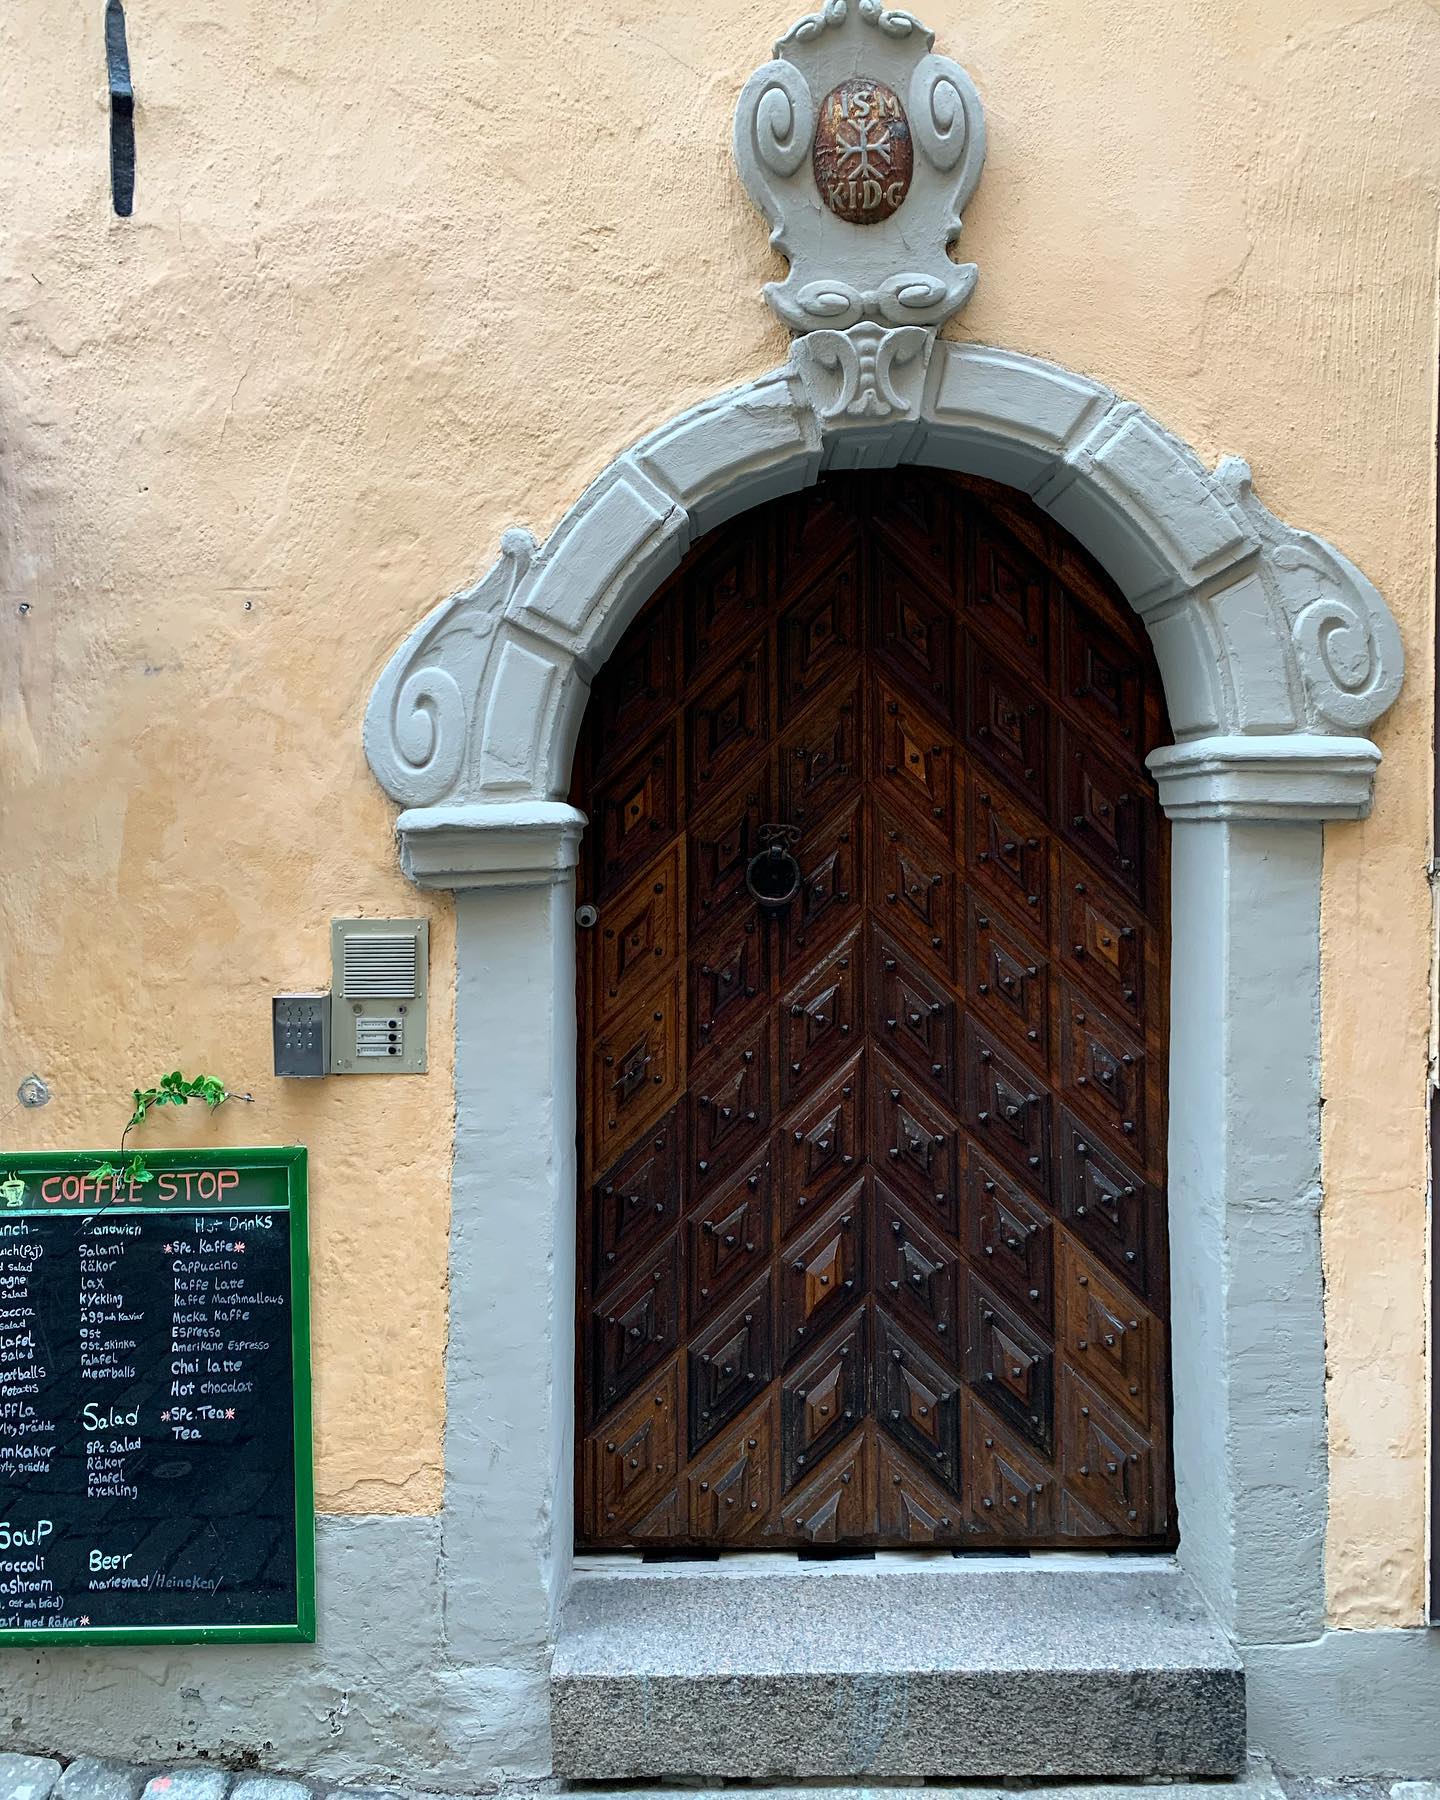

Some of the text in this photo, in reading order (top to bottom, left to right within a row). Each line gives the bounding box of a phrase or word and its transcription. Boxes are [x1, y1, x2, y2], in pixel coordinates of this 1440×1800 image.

[41, 1171, 239, 1203] COFFEE STOP
[79, 1242, 124, 1257] Salami
[199, 1238, 234, 1254] Kaffe
[172, 1260, 239, 1274] Cappuccino
[174, 1277, 209, 1291] Kaffe
[174, 1293, 206, 1307] Kaffe
[80, 1307, 104, 1323] Ägg
[214, 1308, 250, 1321] Kaffe
[170, 1380, 196, 1397] Hot
[82, 1403, 140, 1431] Salad
[171, 1426, 202, 1440] Tea
[89, 1550, 133, 1572] Beer
[24, 1616, 44, 1627] med
